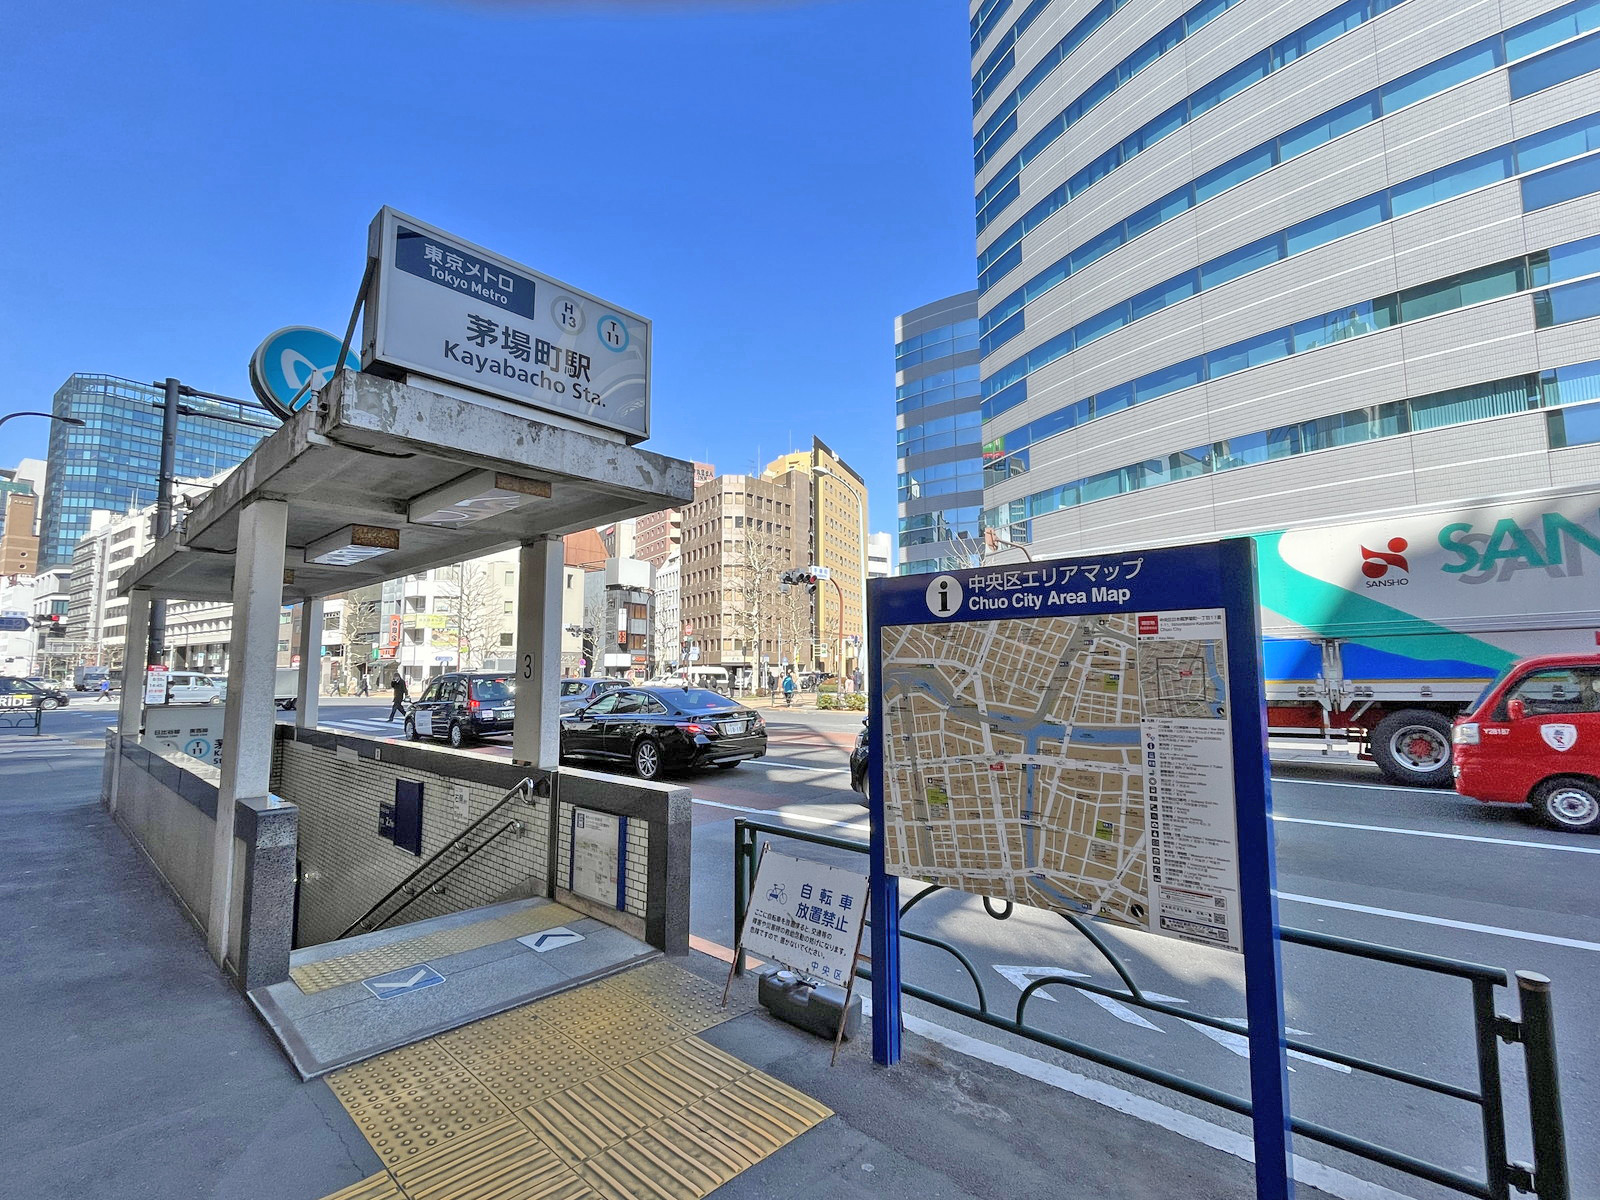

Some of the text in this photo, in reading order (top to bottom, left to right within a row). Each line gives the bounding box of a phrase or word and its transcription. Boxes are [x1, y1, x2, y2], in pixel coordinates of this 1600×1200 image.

[424, 243, 513, 293] 東京メトロ
[429, 264, 508, 305] Tokyo Metro
[561, 313, 576, 328] 13
[564, 303, 574, 315] H
[606, 331, 620, 345] 11
[610, 322, 617, 332] T
[466, 313, 591, 383] 茅場町駅
[444, 340, 606, 407] Kayabacho Sta.
[968, 557, 1144, 593] 中央区エリアマップ
[1365, 578, 1409, 588] SANSHO
[968, 586, 1131, 611] Chuo City Area Map
[524, 654, 532, 679] 3
[800, 883, 854, 911] 自転車
[795, 902, 849, 933] 放置禁止
[811, 961, 843, 980] 中央区
